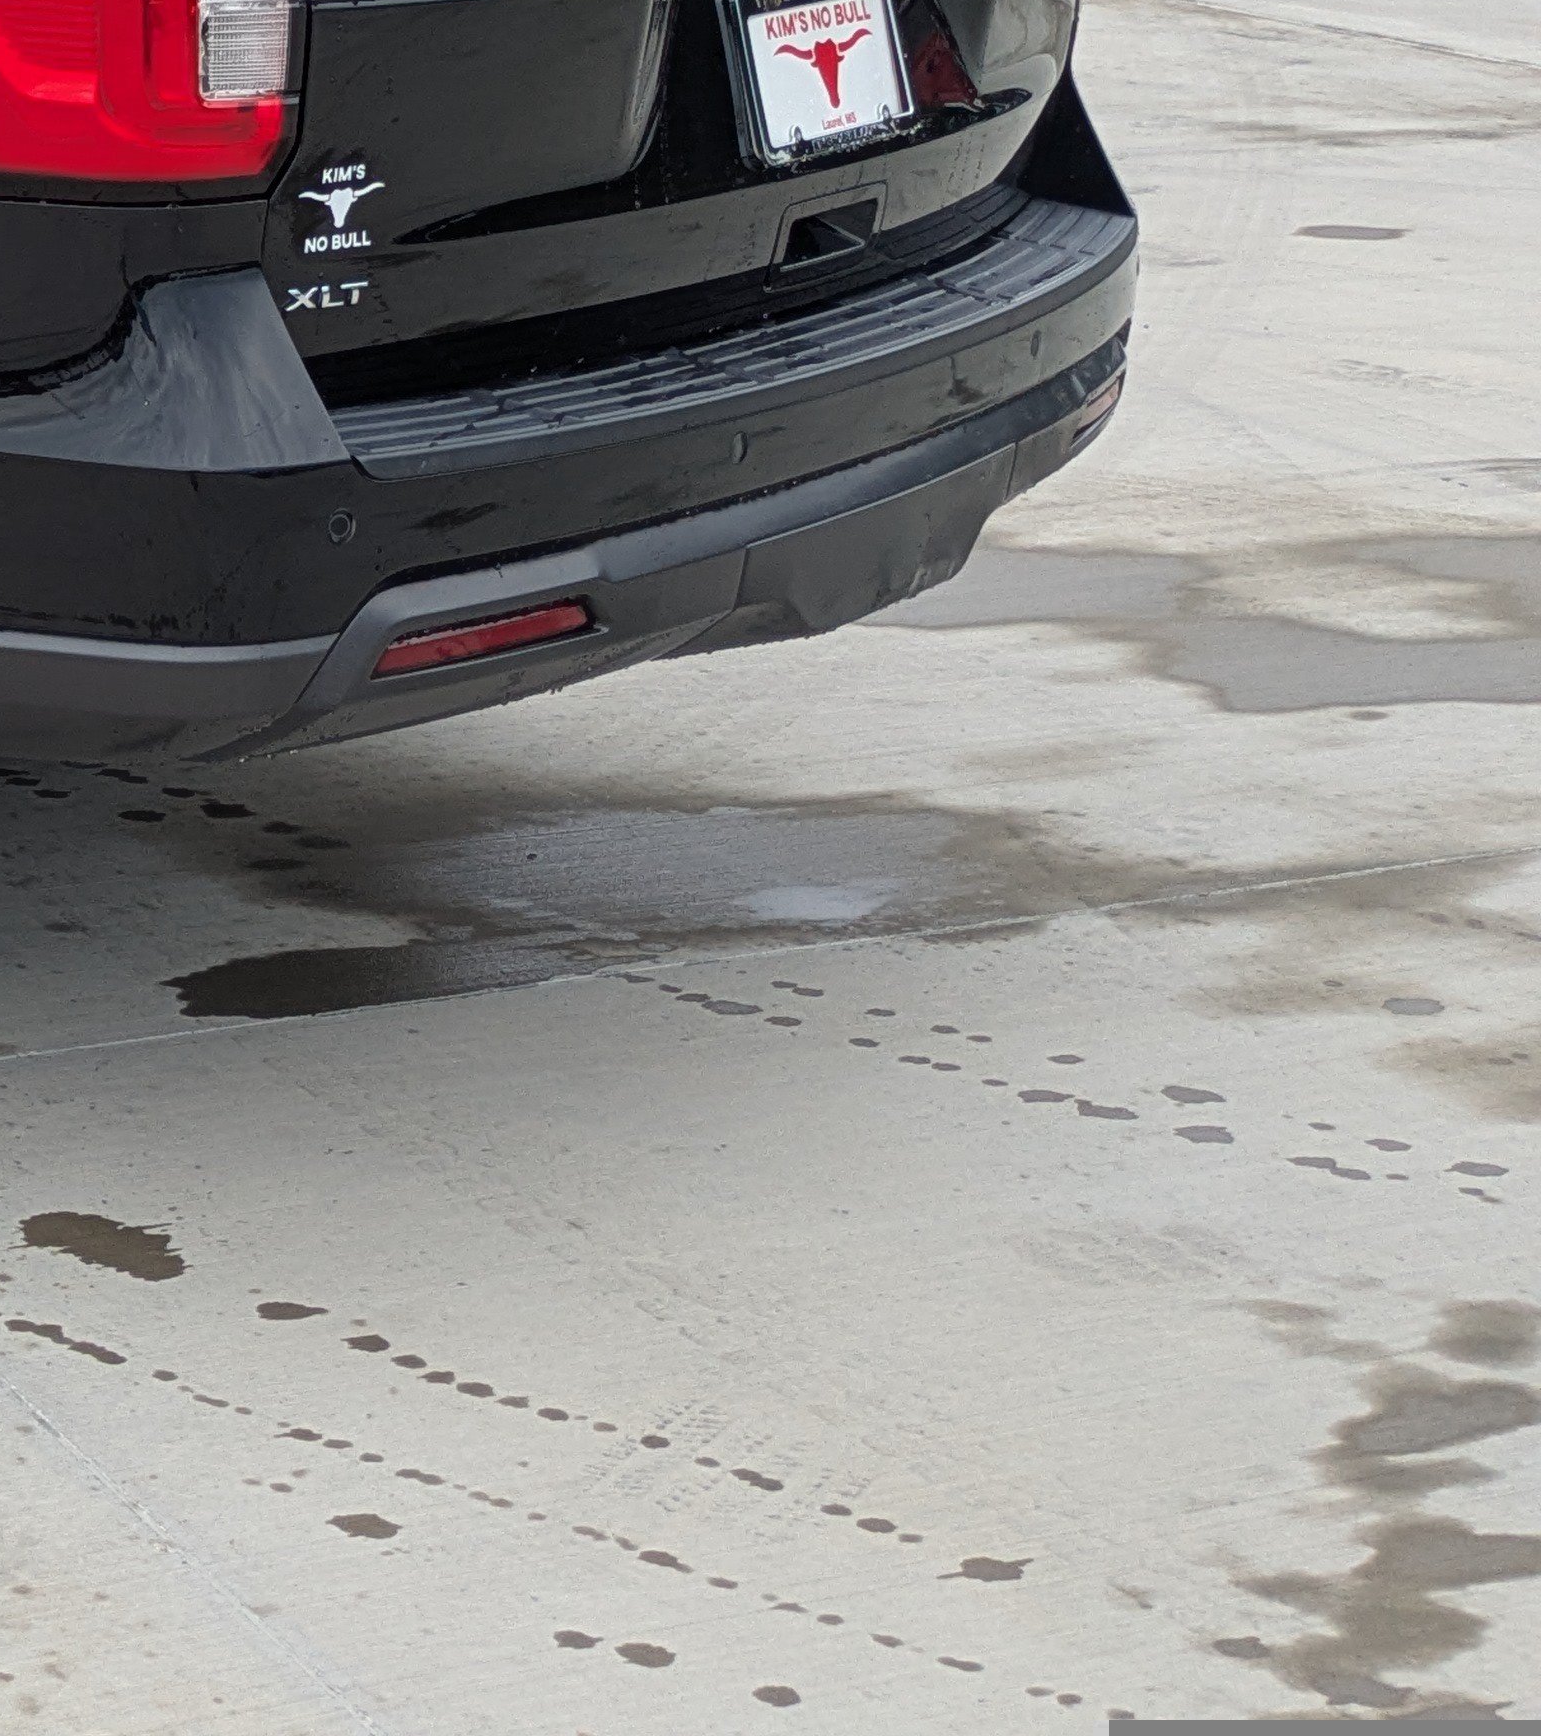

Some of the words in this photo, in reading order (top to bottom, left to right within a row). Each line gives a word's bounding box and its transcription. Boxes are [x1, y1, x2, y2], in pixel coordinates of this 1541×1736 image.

[764, 12, 809, 39] KIM'S
[811, 6, 832, 31] NO
[833, 0, 872, 26] BULL
[322, 164, 366, 184] KIM'S
[304, 236, 328, 253] NO
[331, 231, 371, 250] BULL
[285, 281, 369, 312] XLT
